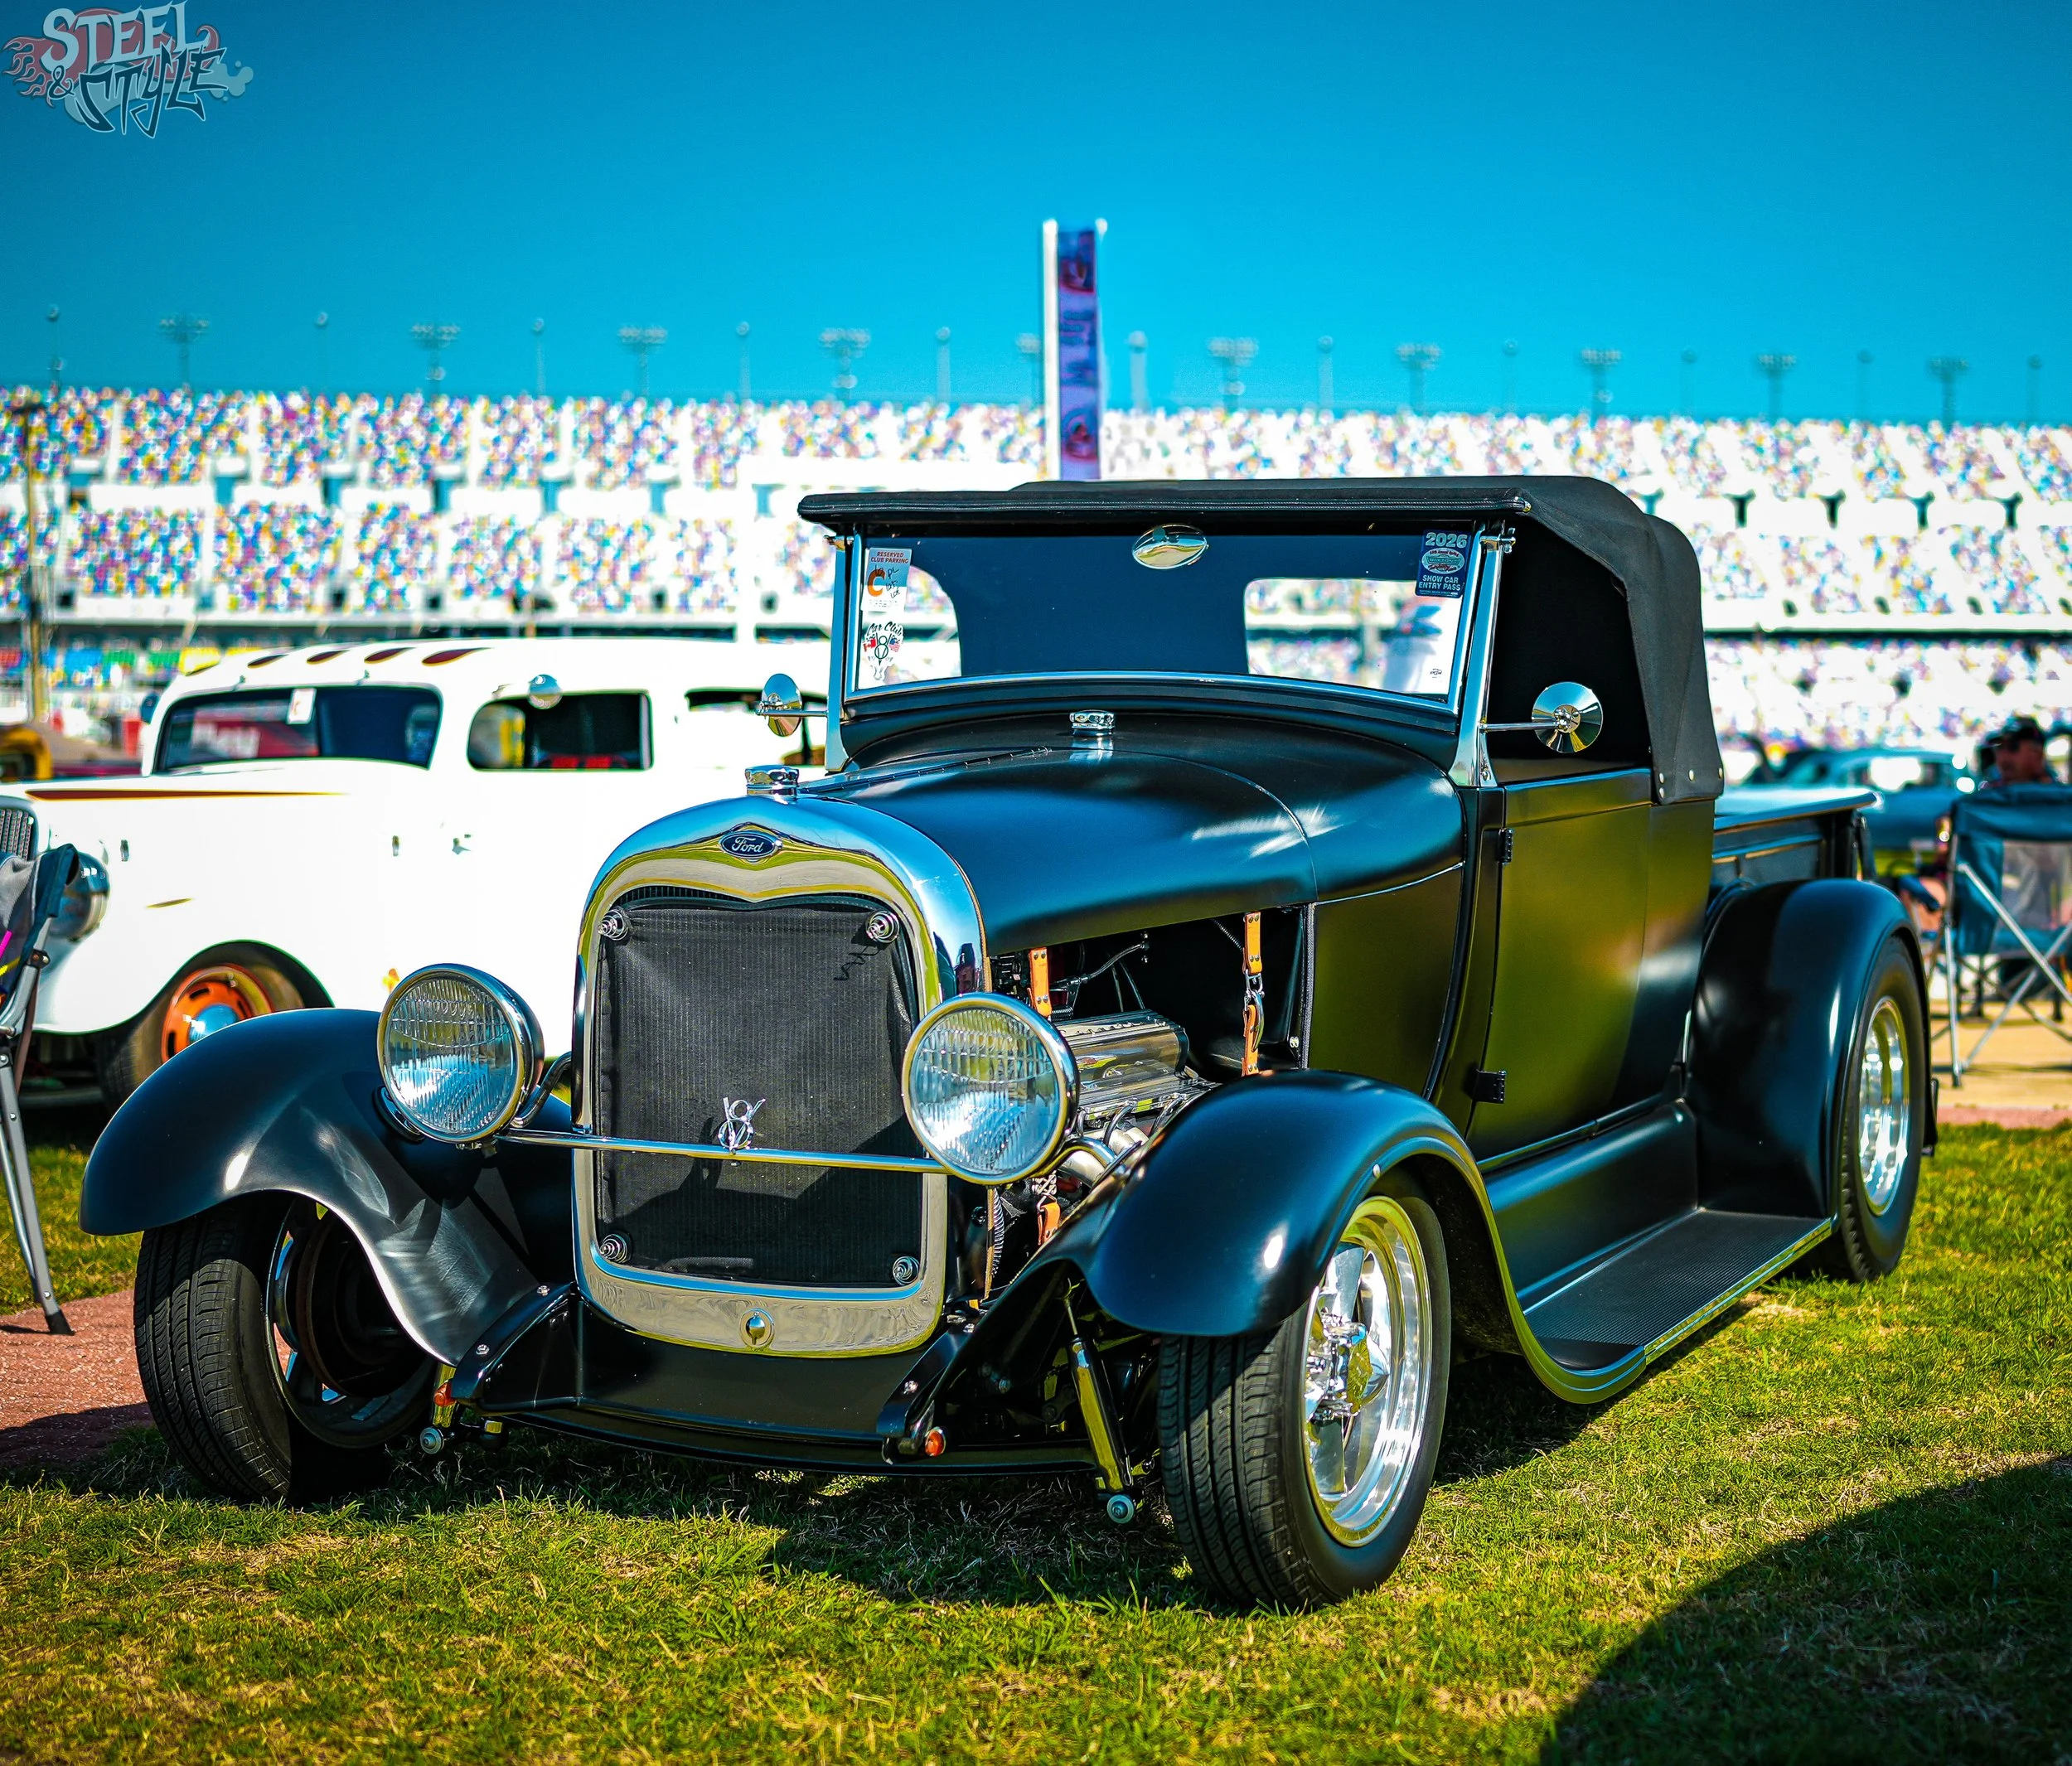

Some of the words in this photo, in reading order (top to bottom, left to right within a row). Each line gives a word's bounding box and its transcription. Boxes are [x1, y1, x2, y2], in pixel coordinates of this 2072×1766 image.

[1426, 532, 1468, 548] 2026
[884, 622, 902, 636] Club
[731, 836, 764, 853] Ford
